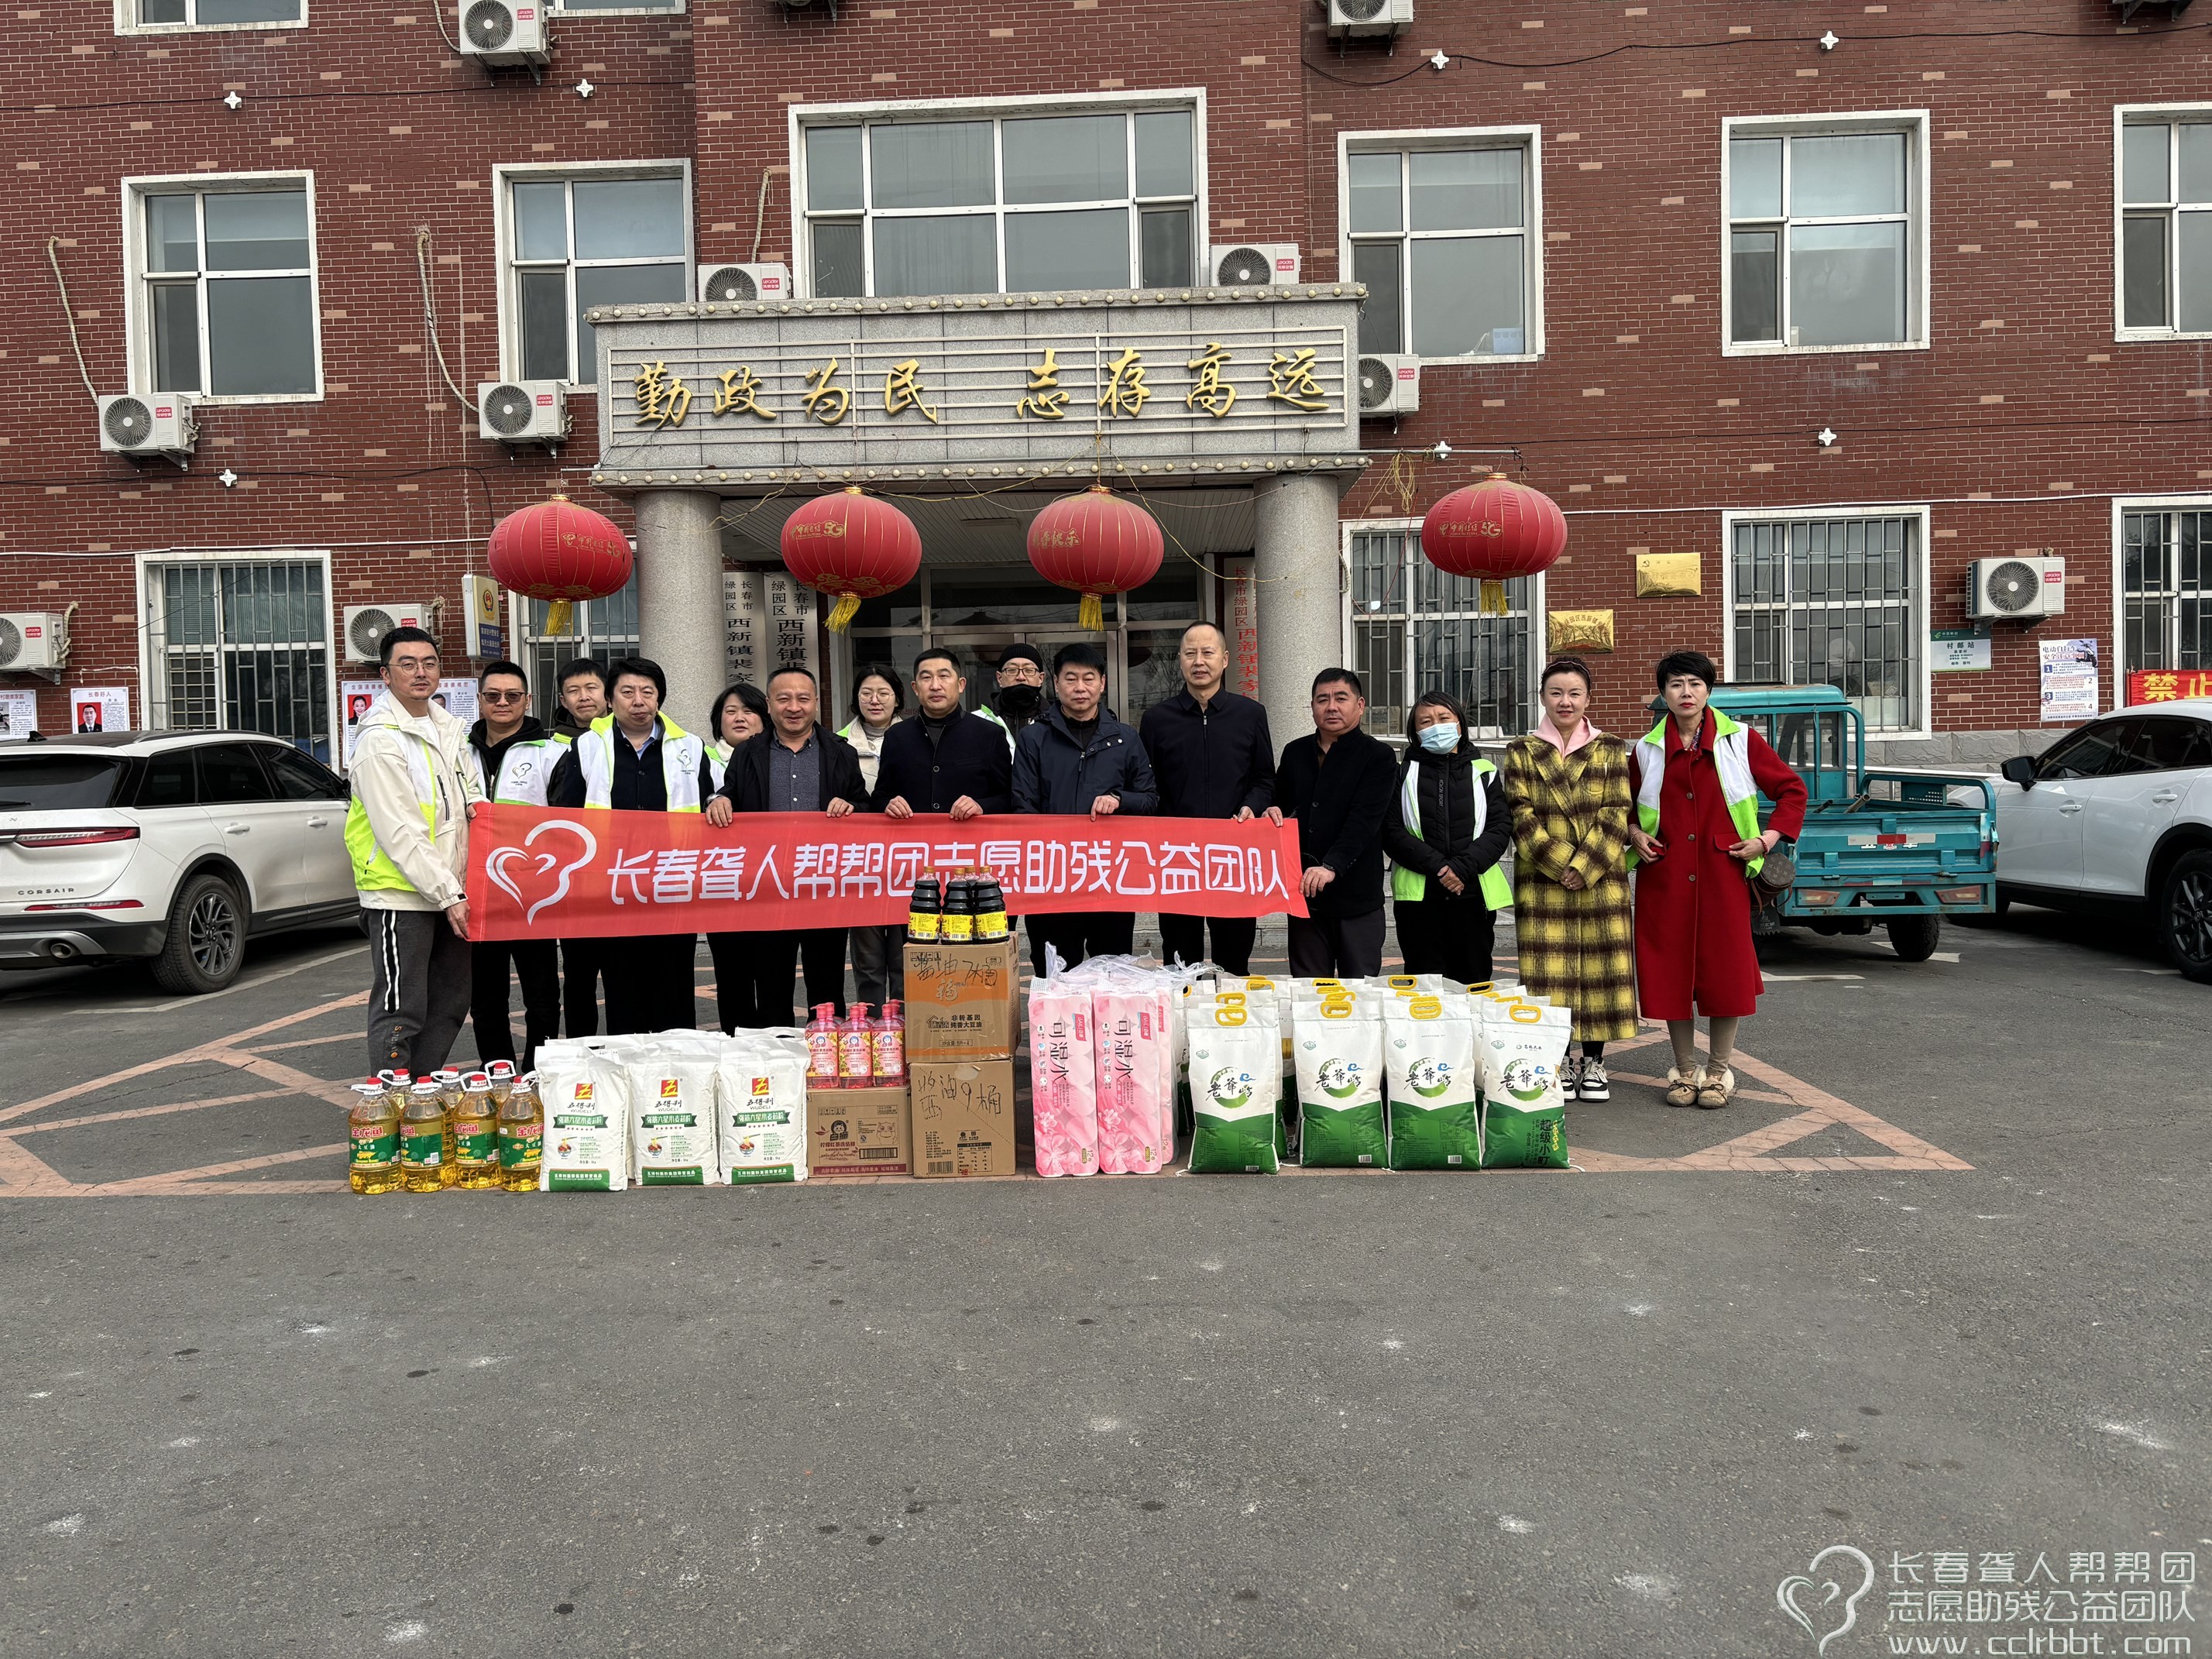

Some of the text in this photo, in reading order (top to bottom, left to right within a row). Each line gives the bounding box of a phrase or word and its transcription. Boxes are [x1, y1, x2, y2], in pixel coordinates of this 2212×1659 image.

[634, 342, 1330, 428] 勤政为民 志存高远
[823, 521, 844, 537] 5G
[1480, 522, 1502, 537] 5G
[724, 581, 737, 611] 绿园区
[740, 581, 754, 611] 长春市
[771, 581, 787, 616] 绿园区
[793, 581, 810, 616] 长春市
[1234, 566, 1248, 627] 长春市绿园区
[1946, 641, 1975, 650] 村邮站
[2143, 672, 2212, 702] 禁止
[936, 979, 958, 1001] 福
[1049, 1021, 1069, 1083] 可湿水
[1114, 1020, 1133, 1081] 可湿水
[1204, 1077, 1253, 1101] 老爷岭
[1314, 1068, 1362, 1091] 老爷岭
[1403, 1067, 1451, 1090] 老爷岭
[1498, 1070, 1549, 1091] 老爷岭
[654, 1100, 682, 1108] 五得利
[746, 1097, 774, 1107] 五得利
[352, 1127, 383, 1138] 金龙鱼
[830, 1132, 849, 1142] 白猫
[1537, 1118, 1551, 1166] 超级小町
